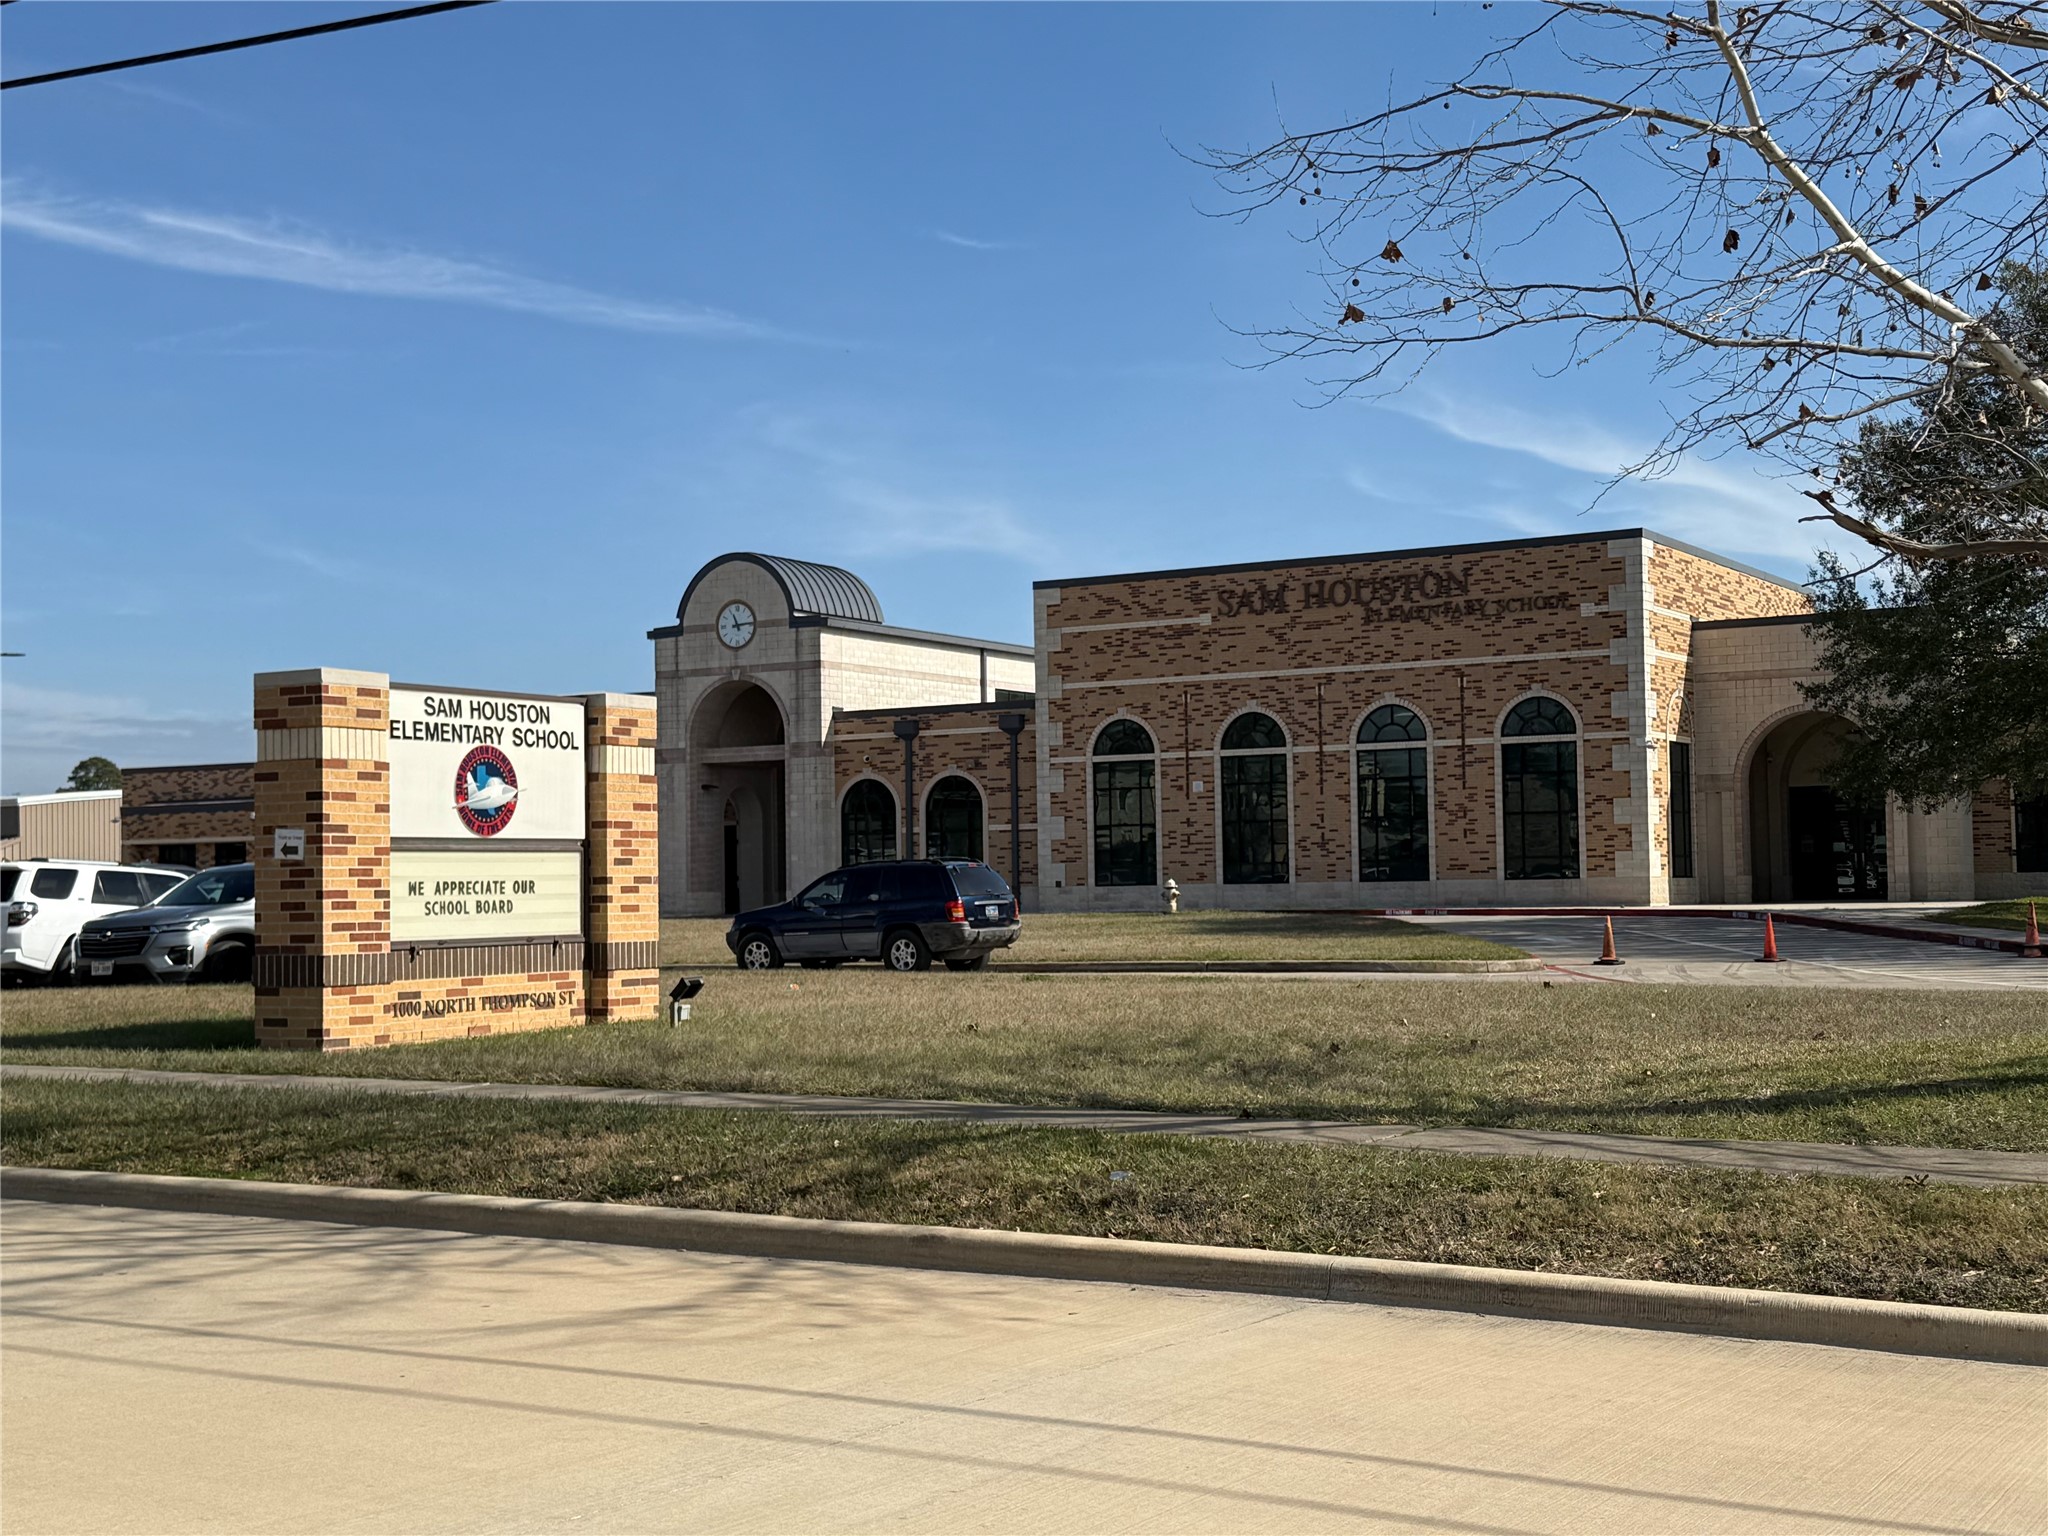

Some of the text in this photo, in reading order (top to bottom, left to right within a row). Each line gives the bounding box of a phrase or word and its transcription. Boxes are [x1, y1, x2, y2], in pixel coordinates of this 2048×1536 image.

[1217, 568, 1473, 617] SAM HOUSTON
[1361, 595, 1570, 626] ELEMENTARY SCHOOL
[424, 696, 550, 725] SAM HOUSTON
[389, 719, 579, 750] ELEMENTARY SCHOOL
[408, 880, 536, 896] WE APPRECIATE OUR
[424, 899, 513, 916] SCHOOL BOARD
[392, 990, 575, 1018] 1000 NORTH THOMPSON ST
